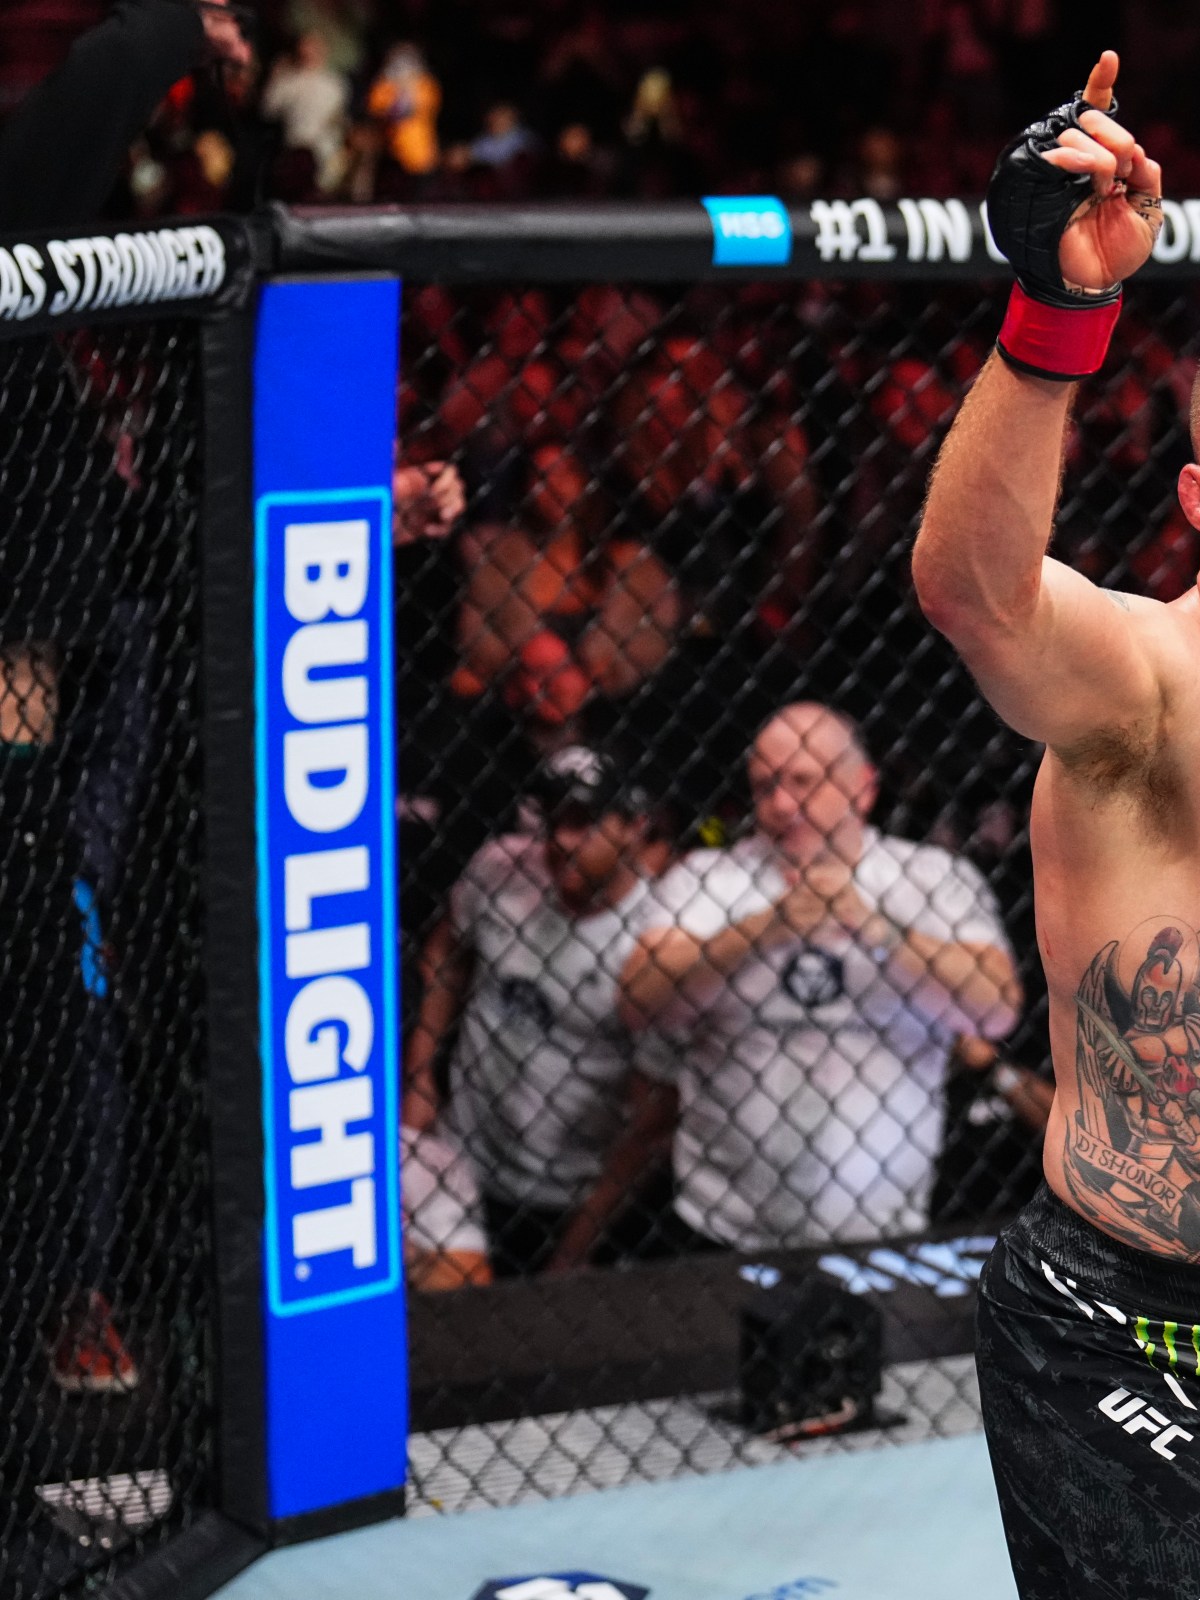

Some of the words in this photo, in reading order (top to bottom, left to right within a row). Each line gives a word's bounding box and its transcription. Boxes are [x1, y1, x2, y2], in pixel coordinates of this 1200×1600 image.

[47, 225, 225, 316] STRONGER
[810, 198, 896, 261] #1
[899, 198, 972, 262] IN
[282, 519, 368, 832] BUD
[284, 846, 376, 1268] LIGHT
[1077, 1133, 1176, 1209] DISHONOR
[1098, 1387, 1195, 1461] UFC
